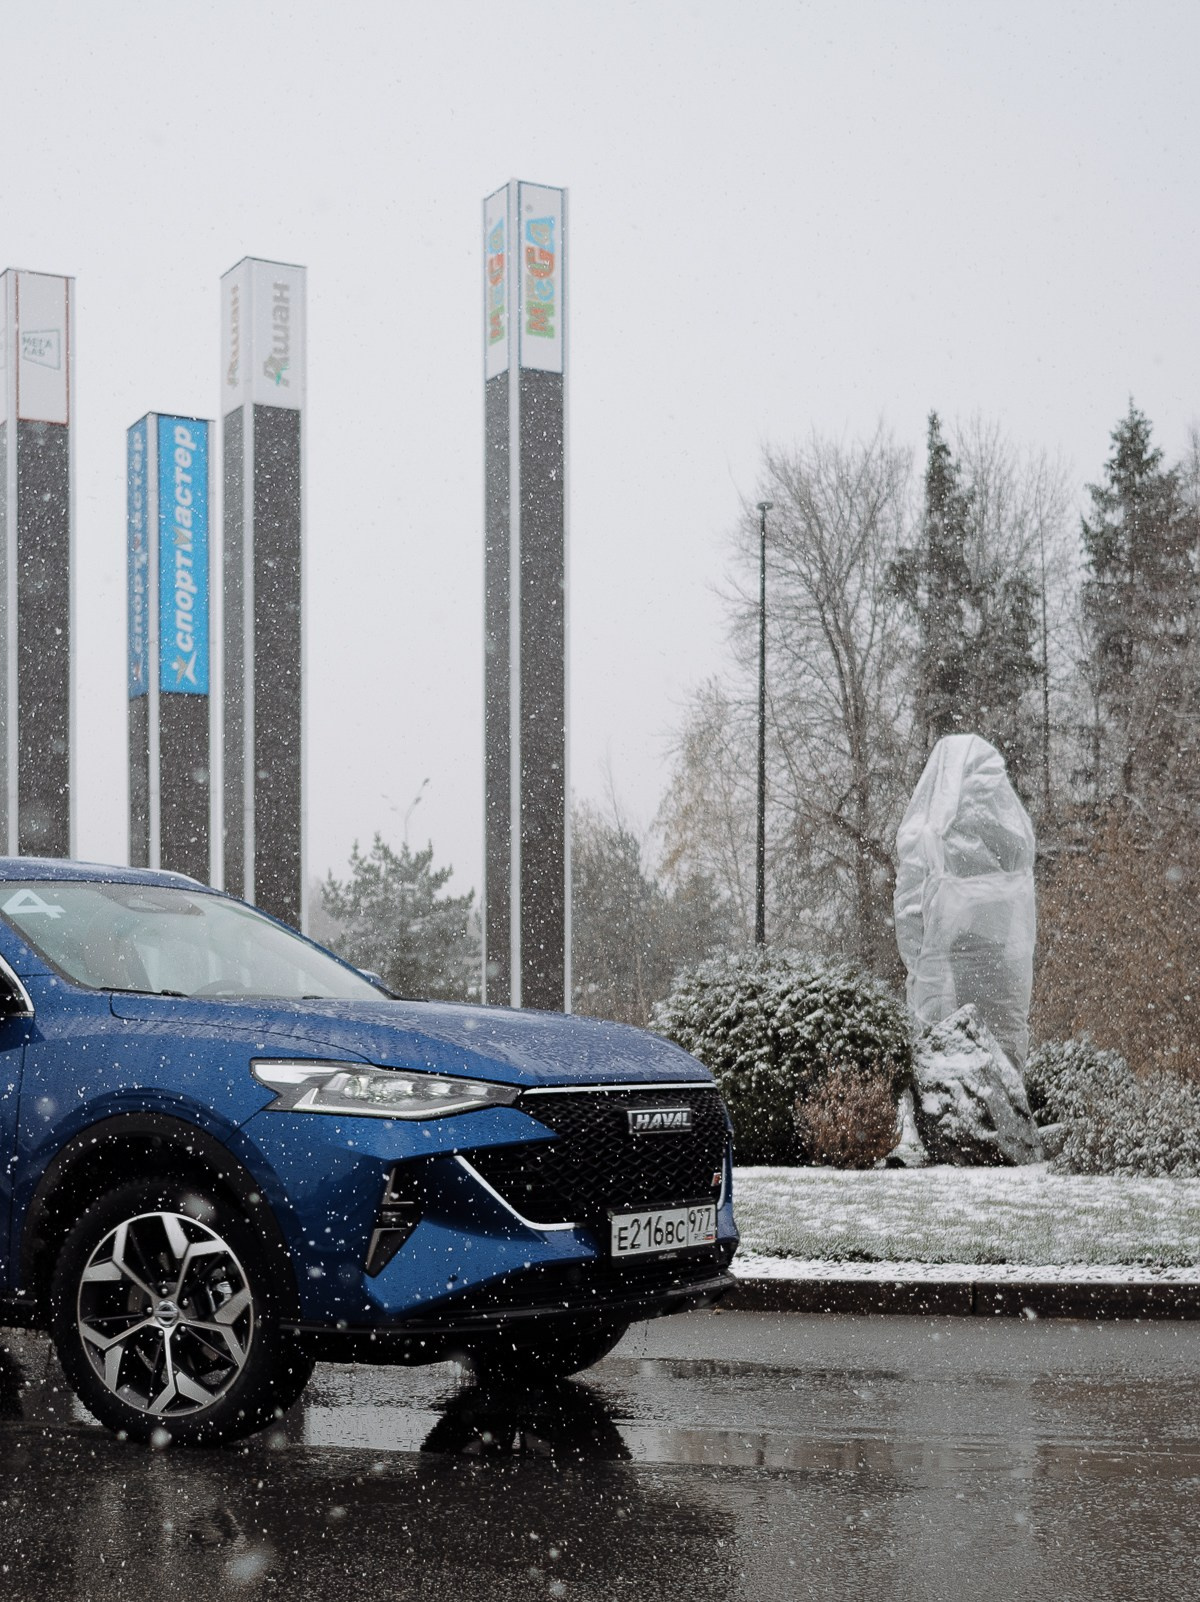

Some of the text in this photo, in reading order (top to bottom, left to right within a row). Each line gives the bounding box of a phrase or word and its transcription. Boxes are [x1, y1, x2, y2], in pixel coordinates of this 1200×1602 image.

[172, 425, 198, 652] спортмастер
[635, 1112, 691, 1130] HAVAL
[688, 1207, 712, 1233] 977
